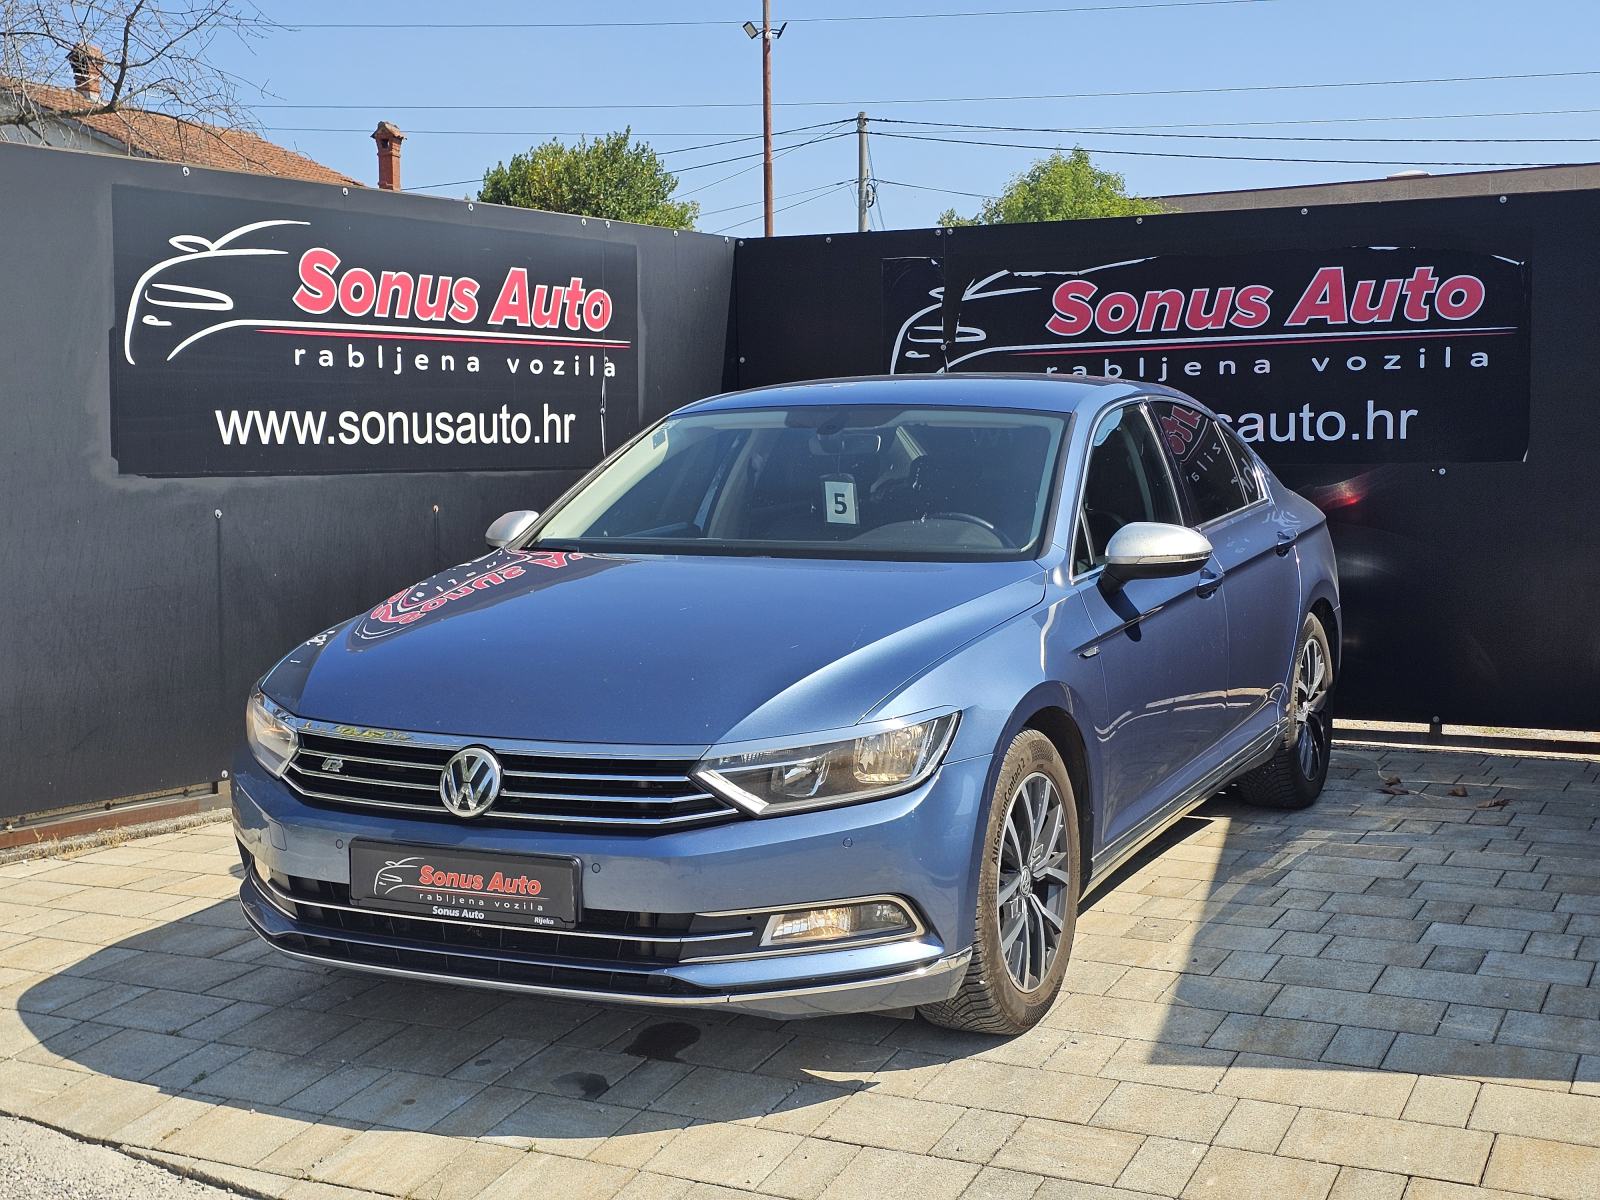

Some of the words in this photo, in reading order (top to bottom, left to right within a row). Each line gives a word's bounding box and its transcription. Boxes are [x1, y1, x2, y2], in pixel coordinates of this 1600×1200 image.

[292, 247, 480, 323] Sonus
[488, 267, 612, 331] Auto
[1045, 280, 1274, 336] Sonus
[1285, 266, 1486, 326] Auto
[294, 344, 480, 376] rabljena
[507, 356, 617, 378] vozila
[1046, 357, 1272, 382] rabljena
[1311, 347, 1489, 372] vozila
[215, 403, 576, 446] www.sonusauto.hr
[834, 492, 847, 514] 5
[418, 865, 484, 890] Sonus
[487, 871, 542, 895] Auto
[419, 892, 485, 906] rabljena
[494, 900, 544, 912] vozila
[432, 906, 460, 917] Sonus
[461, 908, 485, 920] Auto
[534, 917, 555, 926] Rijeka
